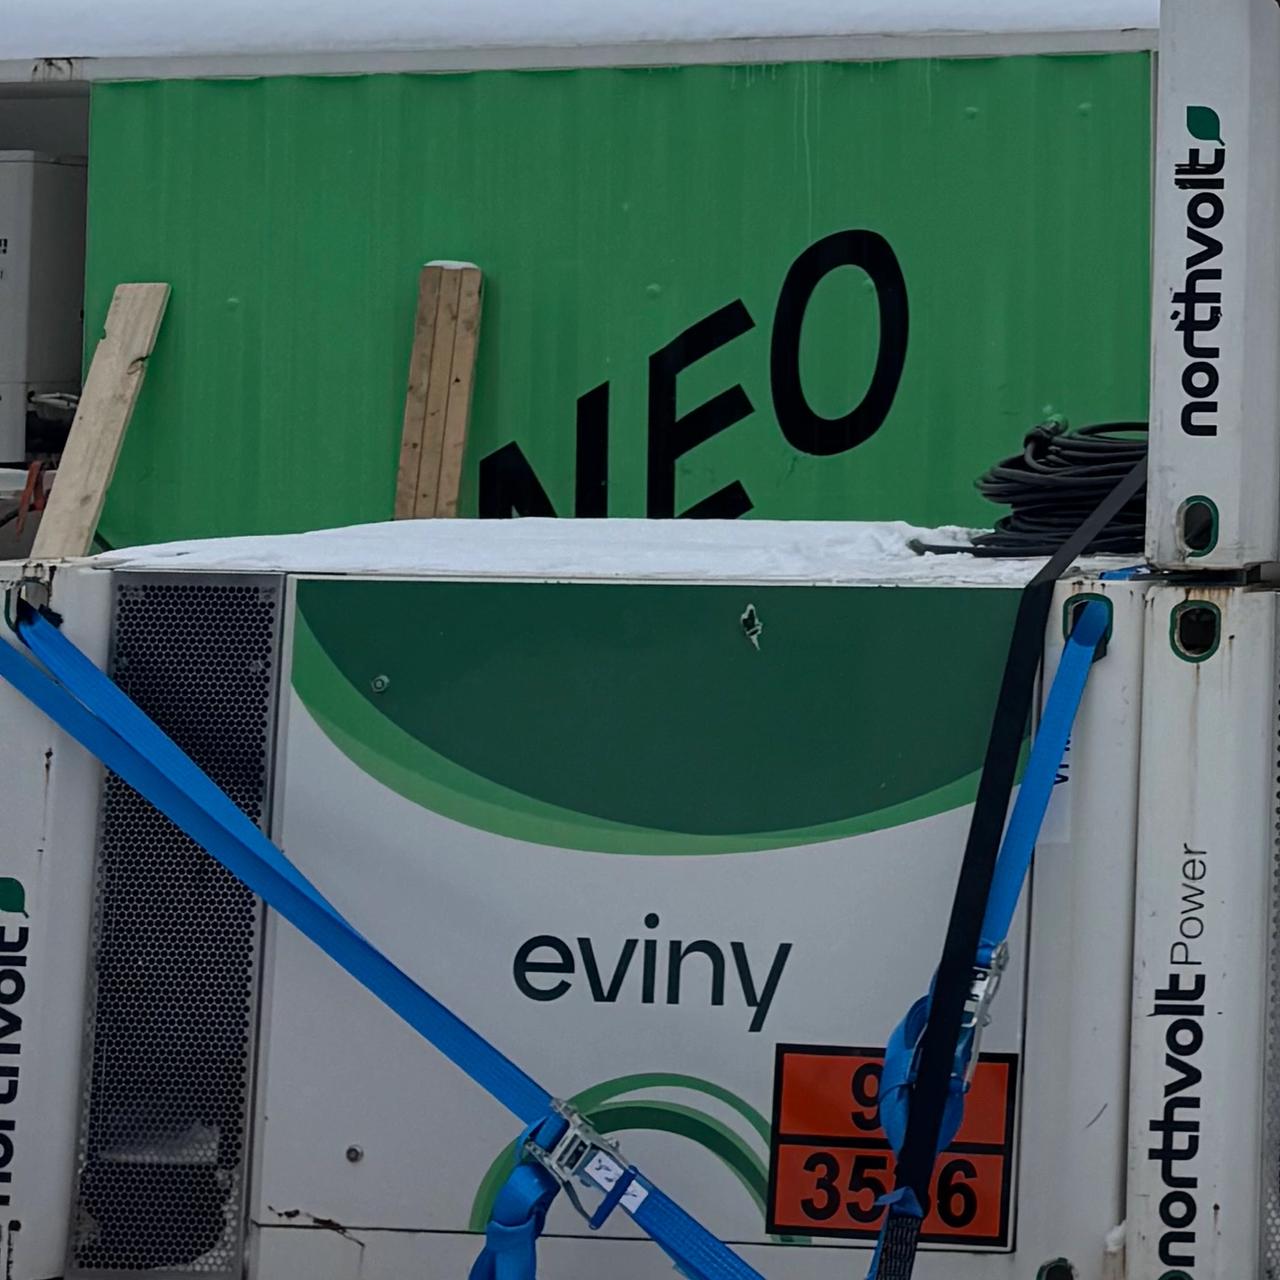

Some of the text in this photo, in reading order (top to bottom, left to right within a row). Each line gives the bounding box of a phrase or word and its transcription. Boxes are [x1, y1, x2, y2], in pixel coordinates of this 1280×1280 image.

[1171, 149, 1225, 436] northvolt
[514, 913, 792, 1032] eviny
[801, 1152, 977, 1228] 356
